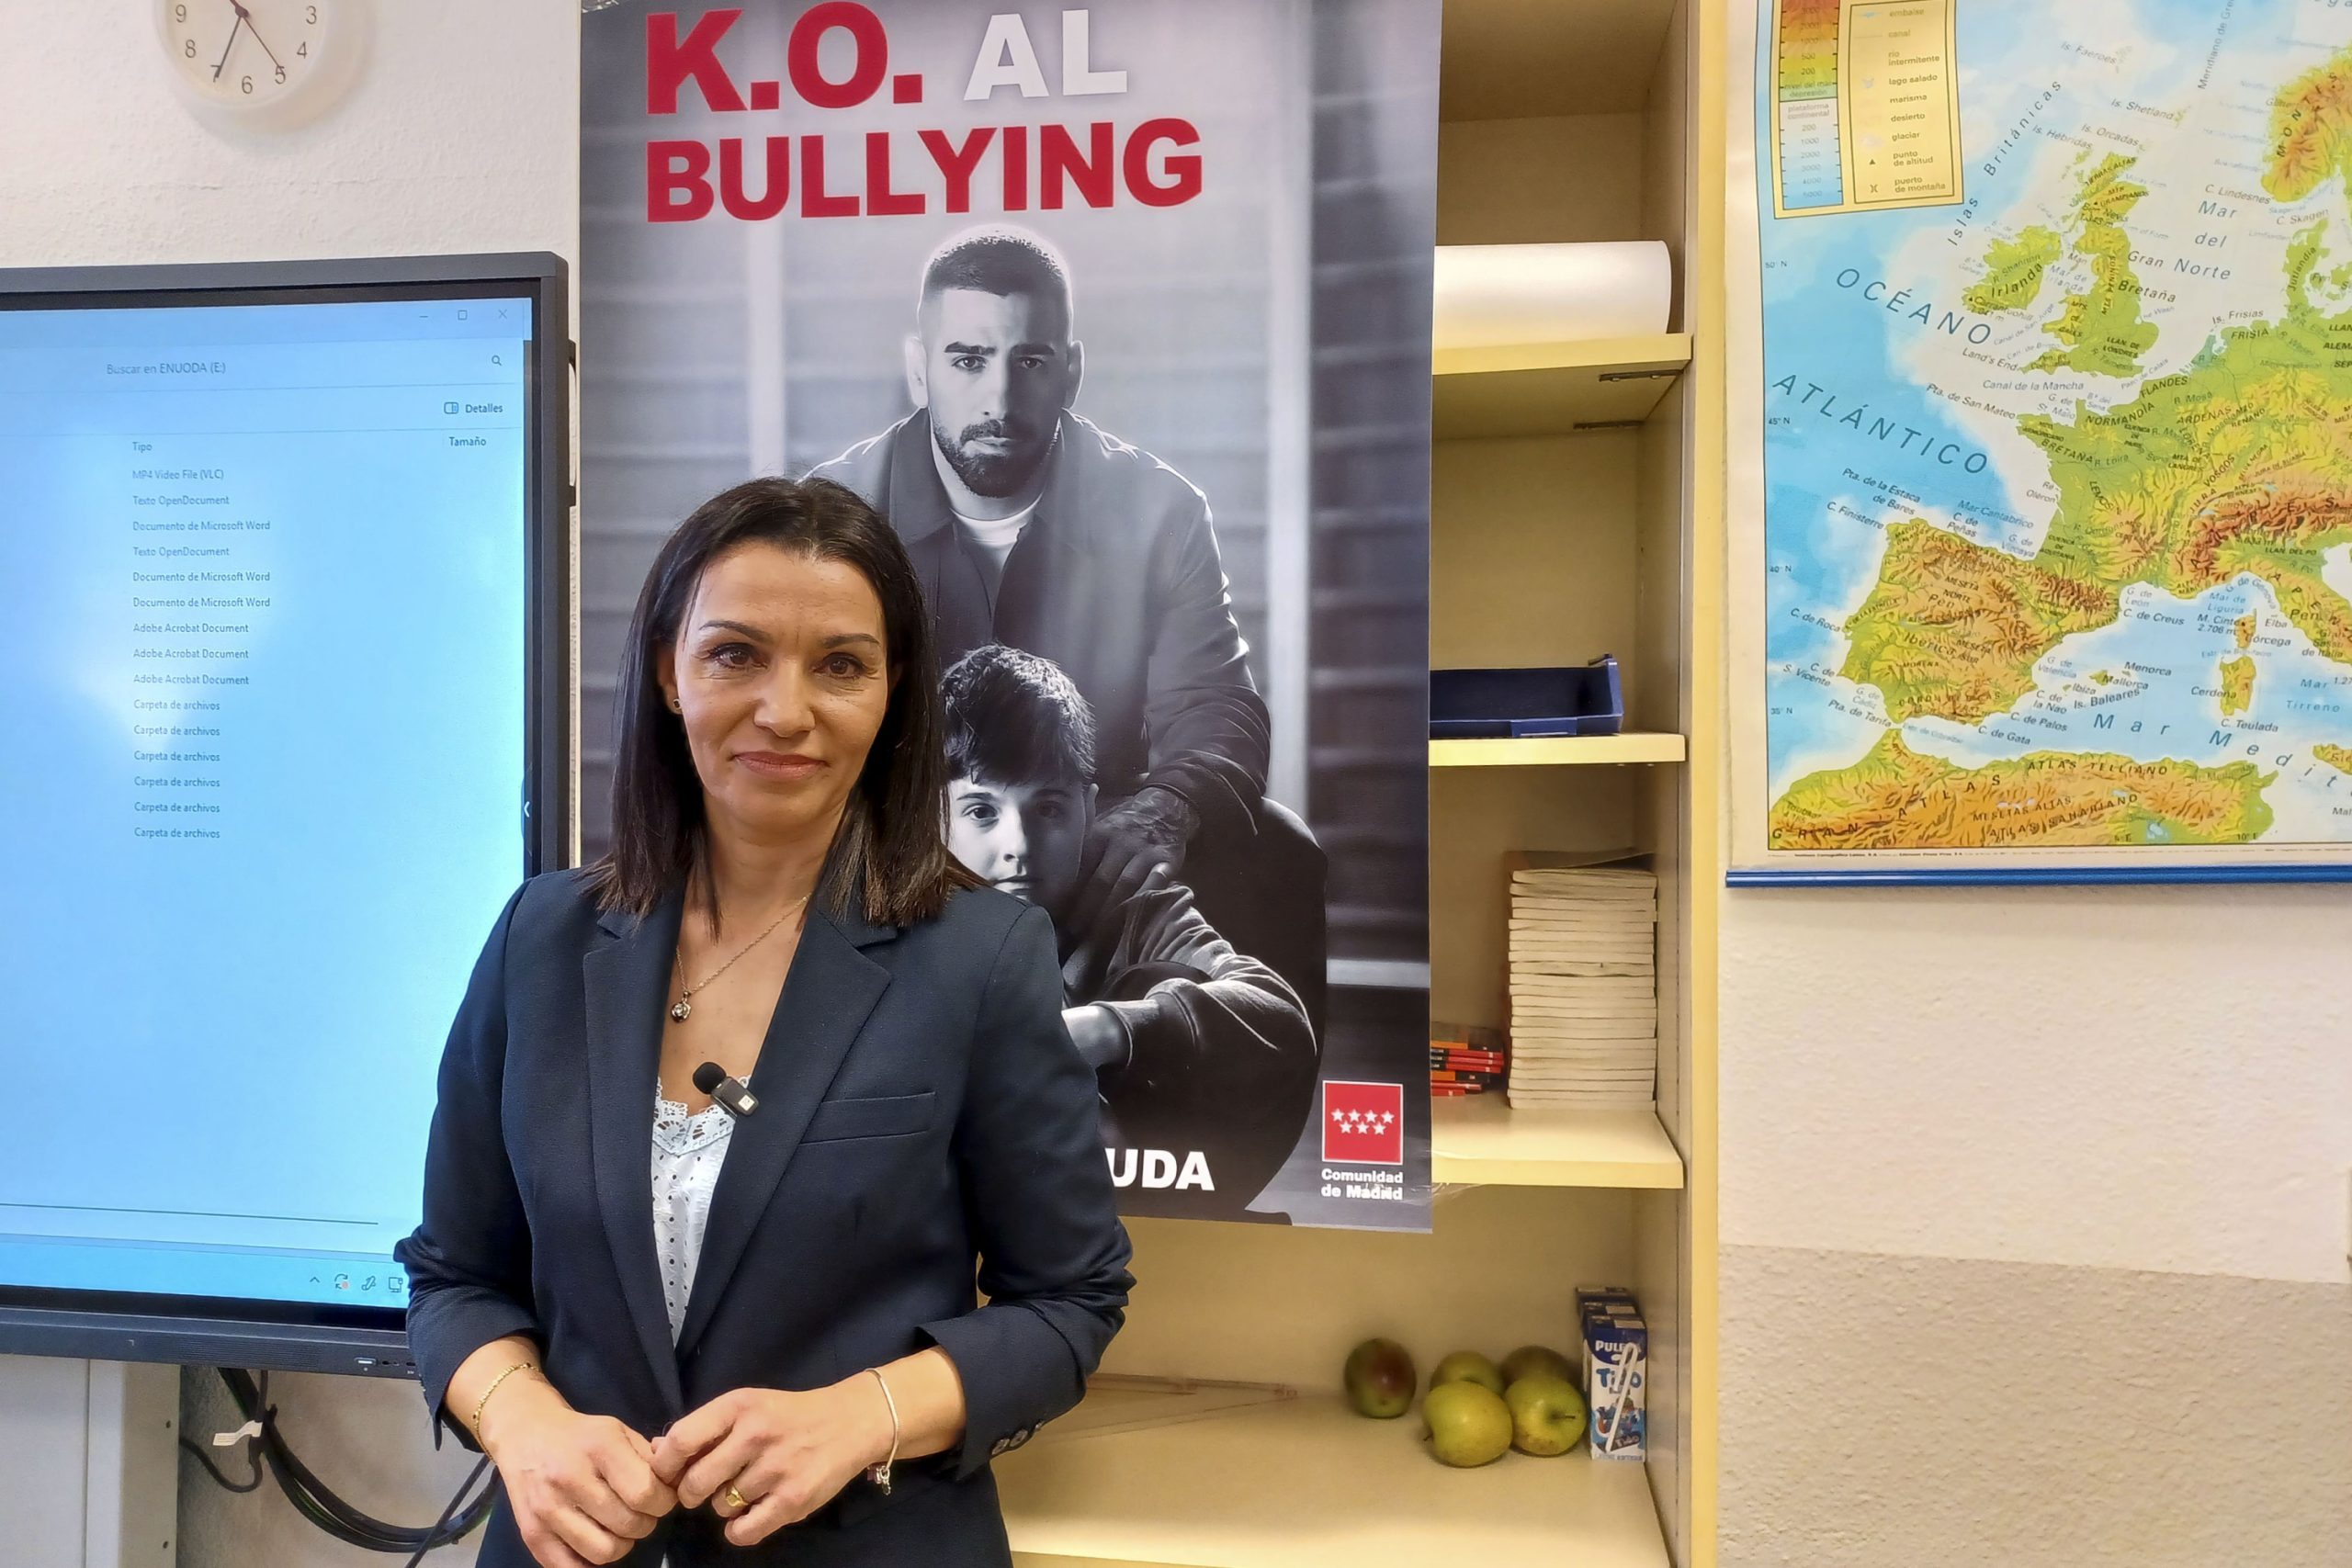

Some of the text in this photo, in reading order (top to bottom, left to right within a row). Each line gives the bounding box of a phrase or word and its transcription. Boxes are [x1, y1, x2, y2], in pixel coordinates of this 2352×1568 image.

[175, 5, 187, 23] 9
[305, 6, 318, 25] 3
[185, 39, 197, 58] 8
[296, 40, 308, 59] 4
[647, 0, 1127, 115] K.O. AL
[209, 64, 221, 83] 7
[274, 65, 287, 85] 5
[241, 75, 254, 94] 6
[1890, 94, 1928, 104] marisma
[1891, 113, 1926, 122] desierto
[2126, 100, 2174, 120] Shetland
[1892, 131, 1920, 141] glaciar
[1983, 81, 2062, 176] Británicas
[647, 118, 1203, 222] BULLYING
[2218, 186, 2271, 205] Lindesnes
[2198, 200, 2237, 219] Mar
[2195, 232, 2227, 248] del
[2128, 250, 2165, 267] Gran
[2174, 258, 2231, 280] Norte
[1991, 263, 2043, 299] Irlanda
[1836, 268, 1991, 344] OCÉANO
[2228, 310, 2264, 320] Frisias
[2231, 328, 2269, 340] FRISIA
[1962, 348, 2018, 372] Land's End
[107, 364, 141, 375] Buscar
[144, 366, 157, 374] en
[160, 363, 208, 374] ENUODA
[1983, 379, 2084, 390] Canal de la Mancha
[2140, 376, 2188, 399] FLANDES
[465, 403, 503, 412] Detalles
[1947, 391, 1961, 402] de
[1962, 396, 1982, 409] San
[1984, 402, 2016, 420] Mateo
[2176, 405, 2233, 425] ARDENAS
[1772, 374, 1987, 474] ATLÁNTICO
[132, 441, 153, 453] Tipo
[448, 436, 487, 446] Tamaño
[132, 468, 224, 480] MP4 Video File (VLC)
[1863, 476, 1877, 487] de
[1878, 480, 1888, 491] la
[1888, 484, 1921, 503] Estaca
[133, 495, 230, 507] Texto OpenDocument
[1872, 494, 1916, 515] de Bares
[1838, 505, 1884, 530] Finisterre
[1965, 516, 1979, 526] de
[132, 521, 271, 531] Documento de Microsoft Word
[133, 546, 230, 558] Texto OpenDocument
[132, 572, 271, 582] Documento de Microsoft Word
[132, 597, 271, 607] Documento de Microsoft Word
[1802, 614, 1815, 624] de
[1816, 617, 1841, 632] Roca
[2137, 611, 2151, 621] de
[2153, 613, 2185, 626] Creus
[2265, 618, 2288, 628] Elba
[133, 624, 249, 634] Adobe Acrobat Document
[133, 649, 249, 659] Adobe Acrobat Document
[2124, 661, 2172, 676] Menorca
[133, 675, 249, 685] Adobe Acrobat Document
[2103, 674, 2149, 690] Mallorca
[2301, 678, 2329, 689] Mar
[2072, 682, 2098, 695] Ibiza
[134, 699, 220, 711] Carpeta de archivos
[2090, 689, 2141, 707] Baleares
[1849, 706, 1863, 717] de
[2286, 700, 2341, 713] Tirreno
[134, 725, 220, 737] Carpeta de archivos
[2023, 715, 2037, 725] de
[2039, 717, 2068, 732] Palos
[2093, 713, 2170, 736] Mar
[2236, 719, 2278, 732] Teulada
[1991, 728, 2005, 739] de
[2007, 732, 2031, 745] Gata
[134, 750, 220, 762] Carpeta de archivos
[134, 776, 220, 788] Carpeta de archivos
[134, 802, 220, 814] Carpeta de archivos
[134, 828, 220, 840] Carpeta de archivos
[1104, 1147, 1216, 1191] UDA
[1321, 1168, 1404, 1183] Comunidad
[1320, 1183, 1404, 1201] de Madrid
